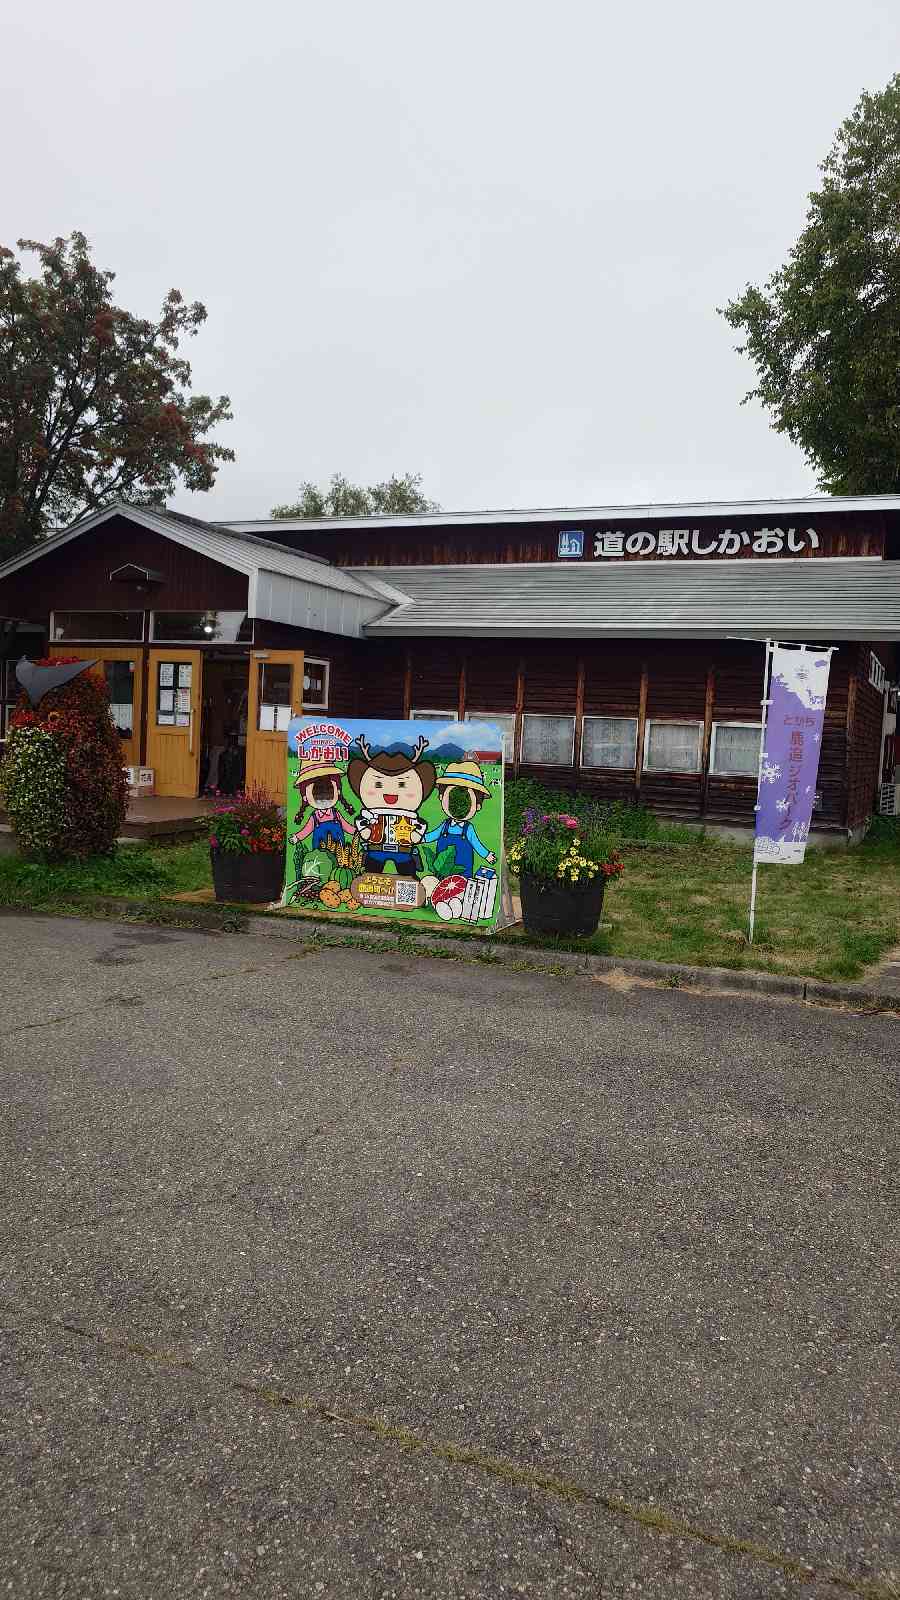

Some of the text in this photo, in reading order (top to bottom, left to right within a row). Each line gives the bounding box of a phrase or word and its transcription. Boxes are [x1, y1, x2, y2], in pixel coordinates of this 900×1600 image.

[593, 527, 820, 557] 道の駅しかおい
[295, 723, 353, 747] WELCOME
[298, 744, 349, 761] しかおい
